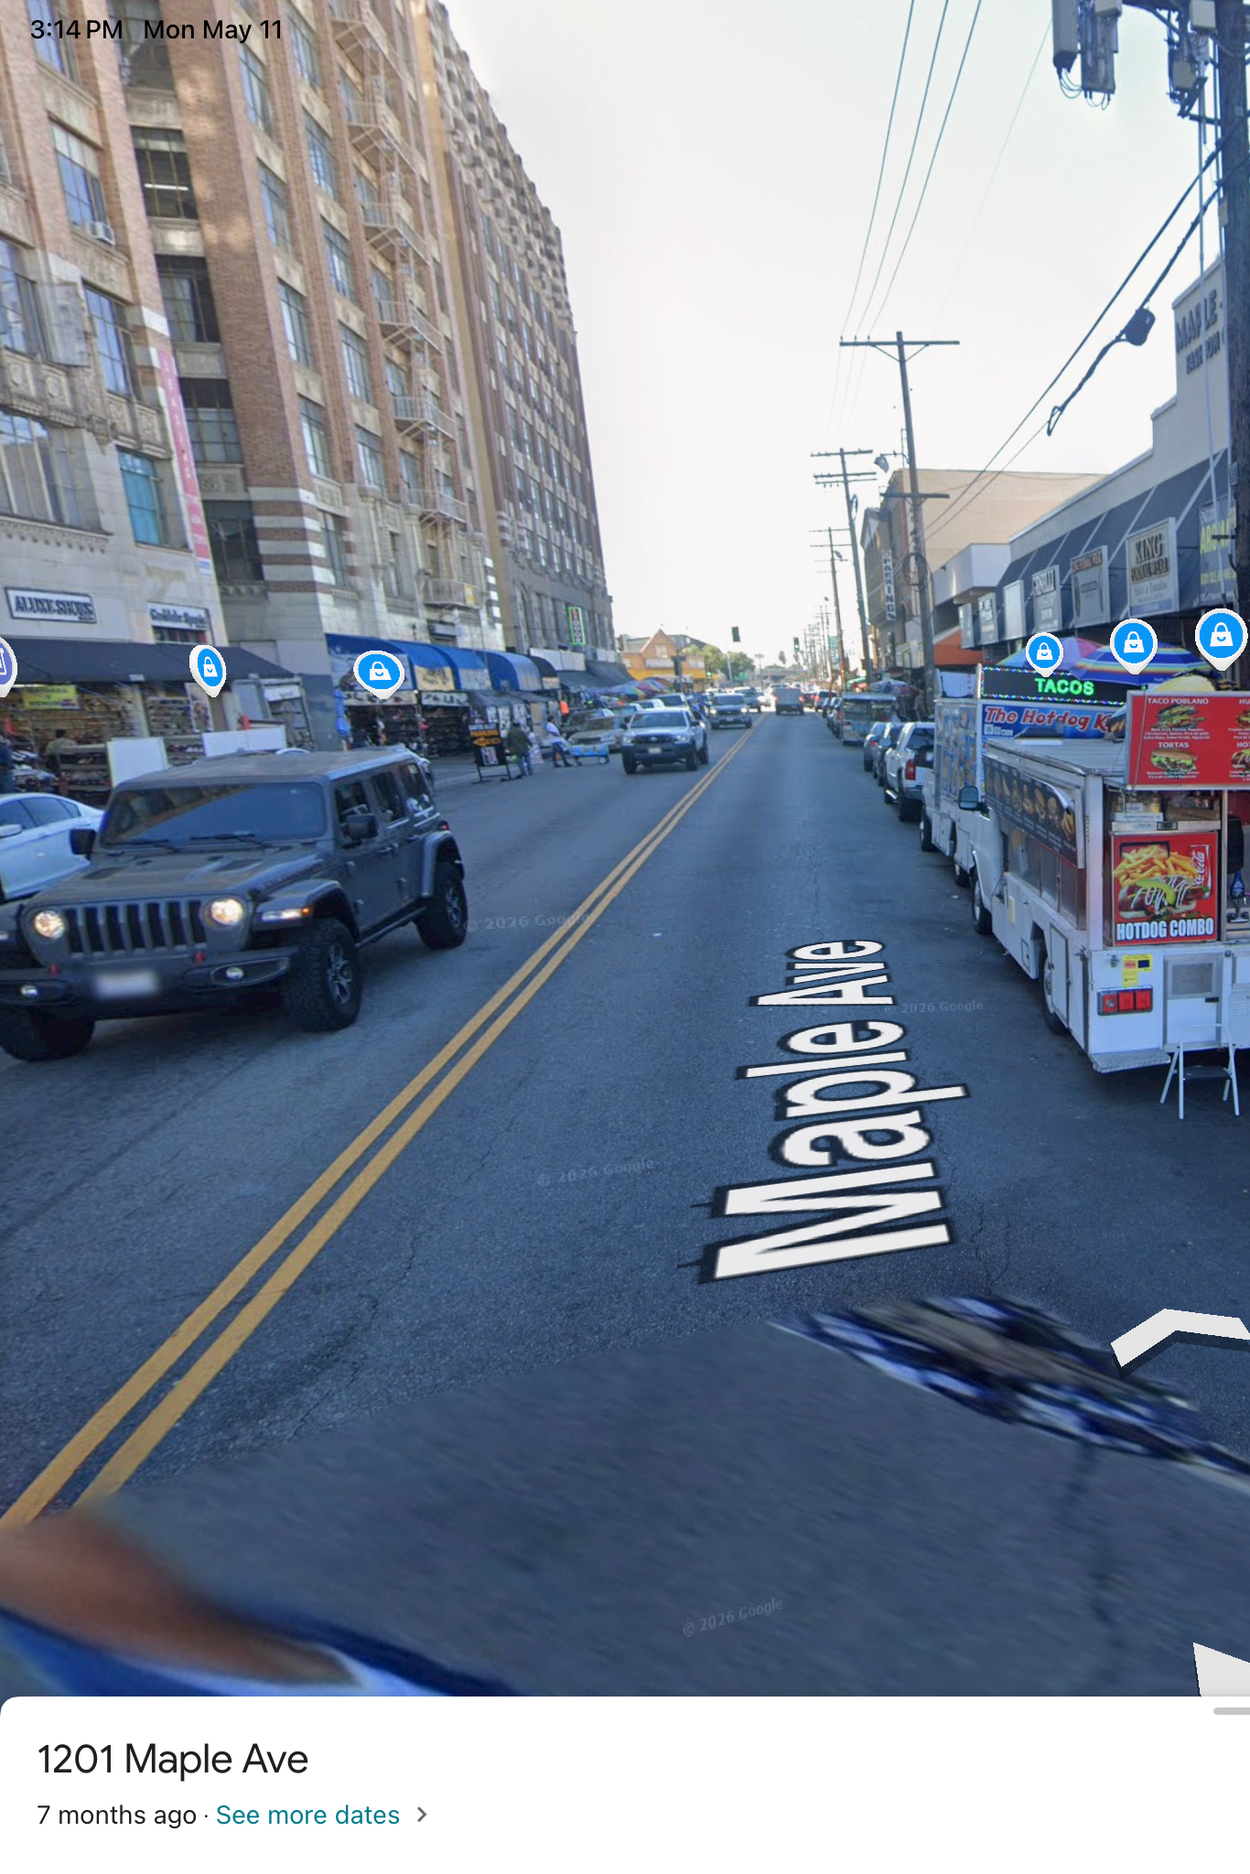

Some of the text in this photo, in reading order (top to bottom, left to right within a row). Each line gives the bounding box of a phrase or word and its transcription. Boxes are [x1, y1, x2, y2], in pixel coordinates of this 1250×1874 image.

[1034, 677, 1094, 696] TACOS
[984, 706, 1018, 724] The
[1021, 708, 1091, 732] Hotdog
[1116, 917, 1214, 941] HOTDOG COMBO
